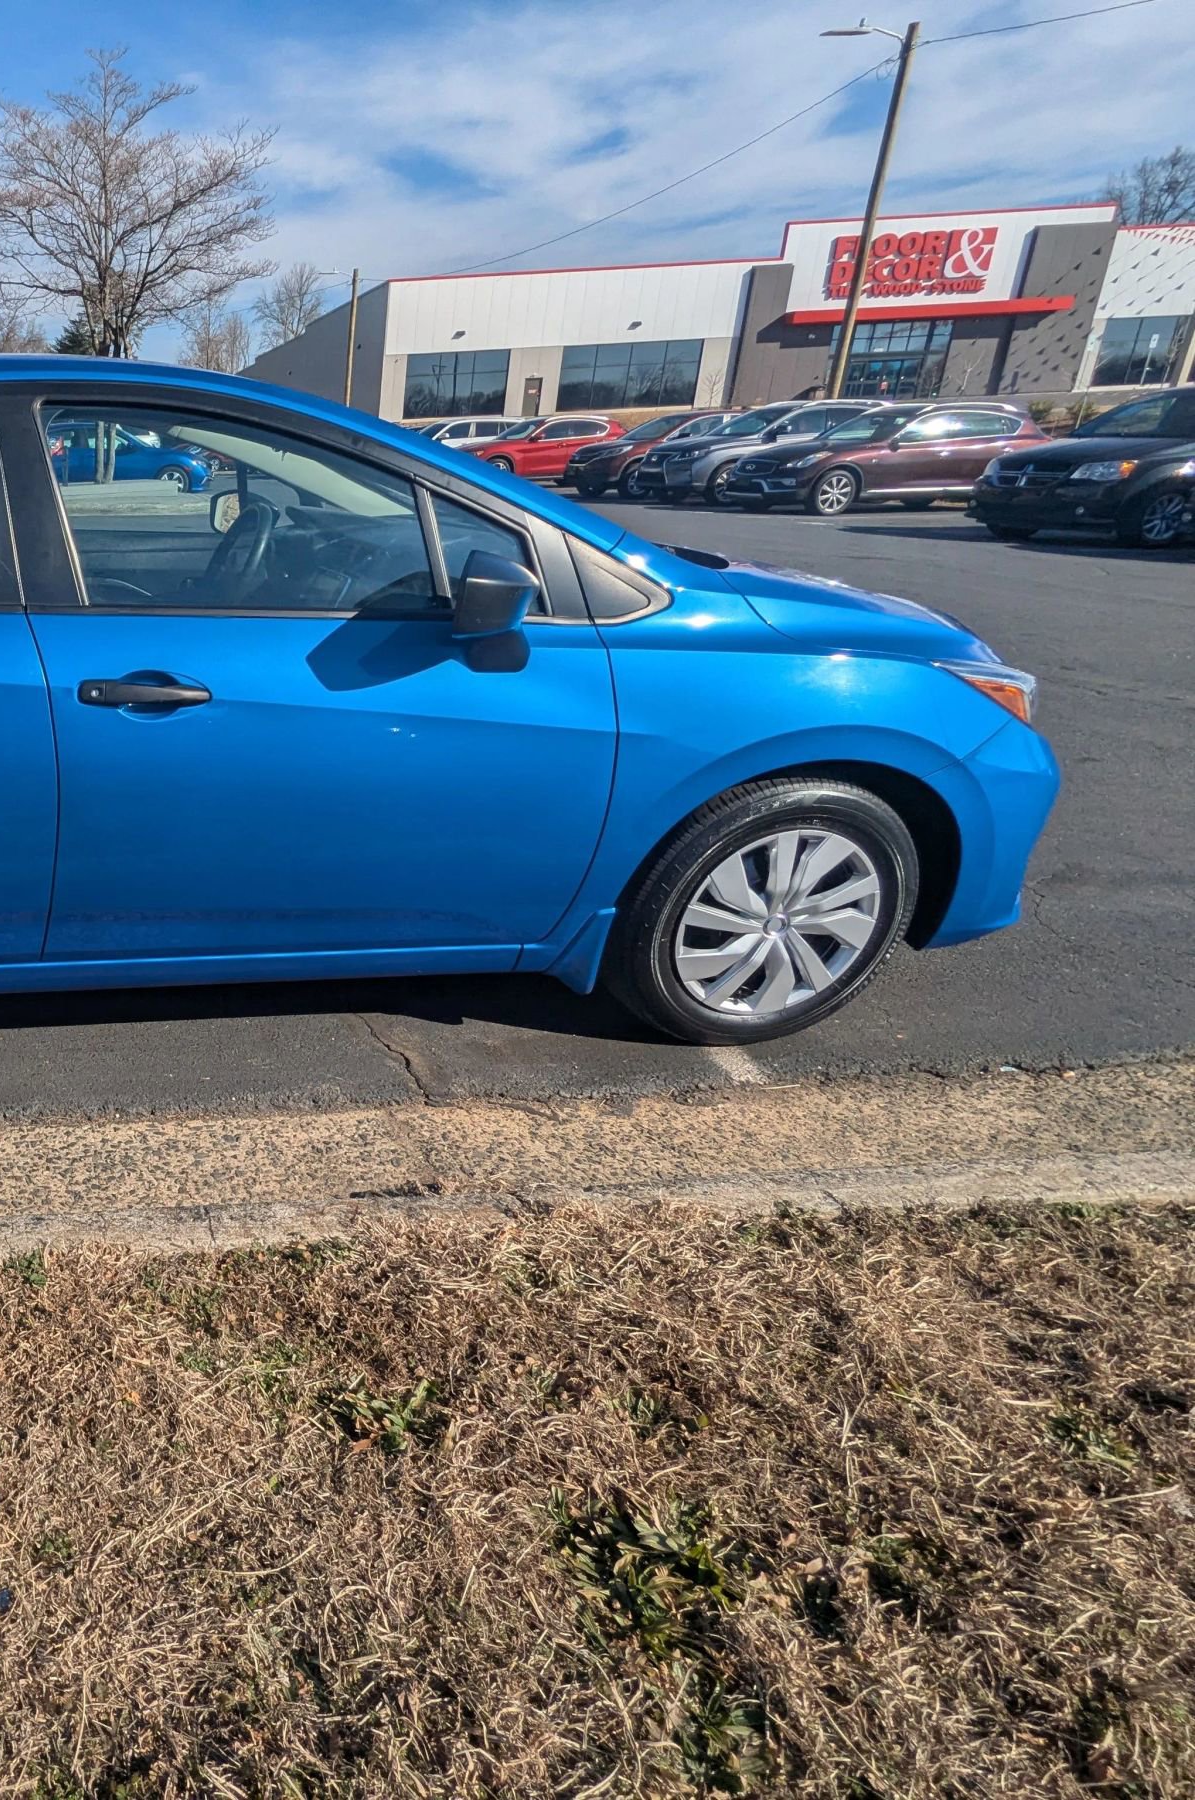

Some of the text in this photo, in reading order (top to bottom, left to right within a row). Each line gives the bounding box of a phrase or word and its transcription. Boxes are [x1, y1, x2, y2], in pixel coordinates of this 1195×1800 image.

[834, 228, 996, 278] FOOR &
[872, 281, 922, 295] WOOD
[932, 278, 987, 293] STONE
